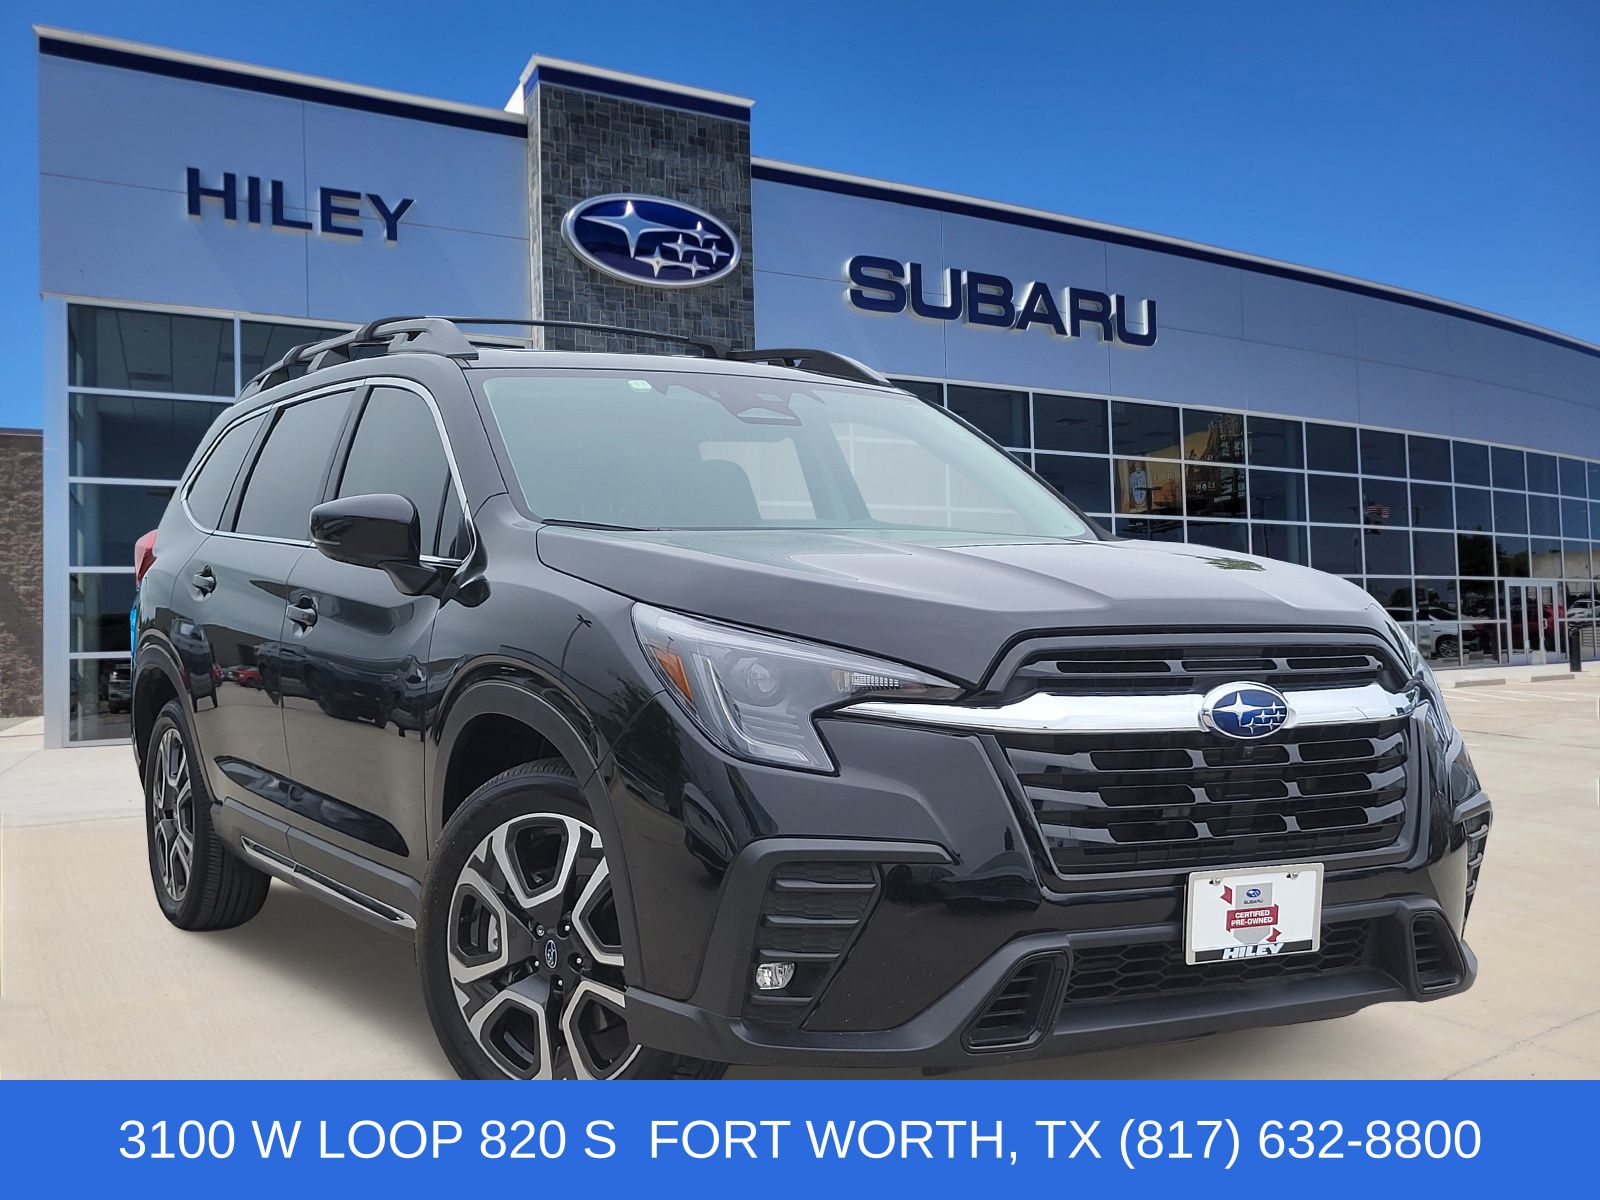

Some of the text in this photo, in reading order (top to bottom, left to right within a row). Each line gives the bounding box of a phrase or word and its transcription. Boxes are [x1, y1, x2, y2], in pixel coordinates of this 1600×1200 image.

[186, 166, 416, 243] HILEY
[846, 254, 1158, 347] SUBARU
[1231, 916, 1273, 926] PRE-OWNED
[1235, 909, 1270, 919] CERTIFIED
[1222, 943, 1284, 960] HILEY
